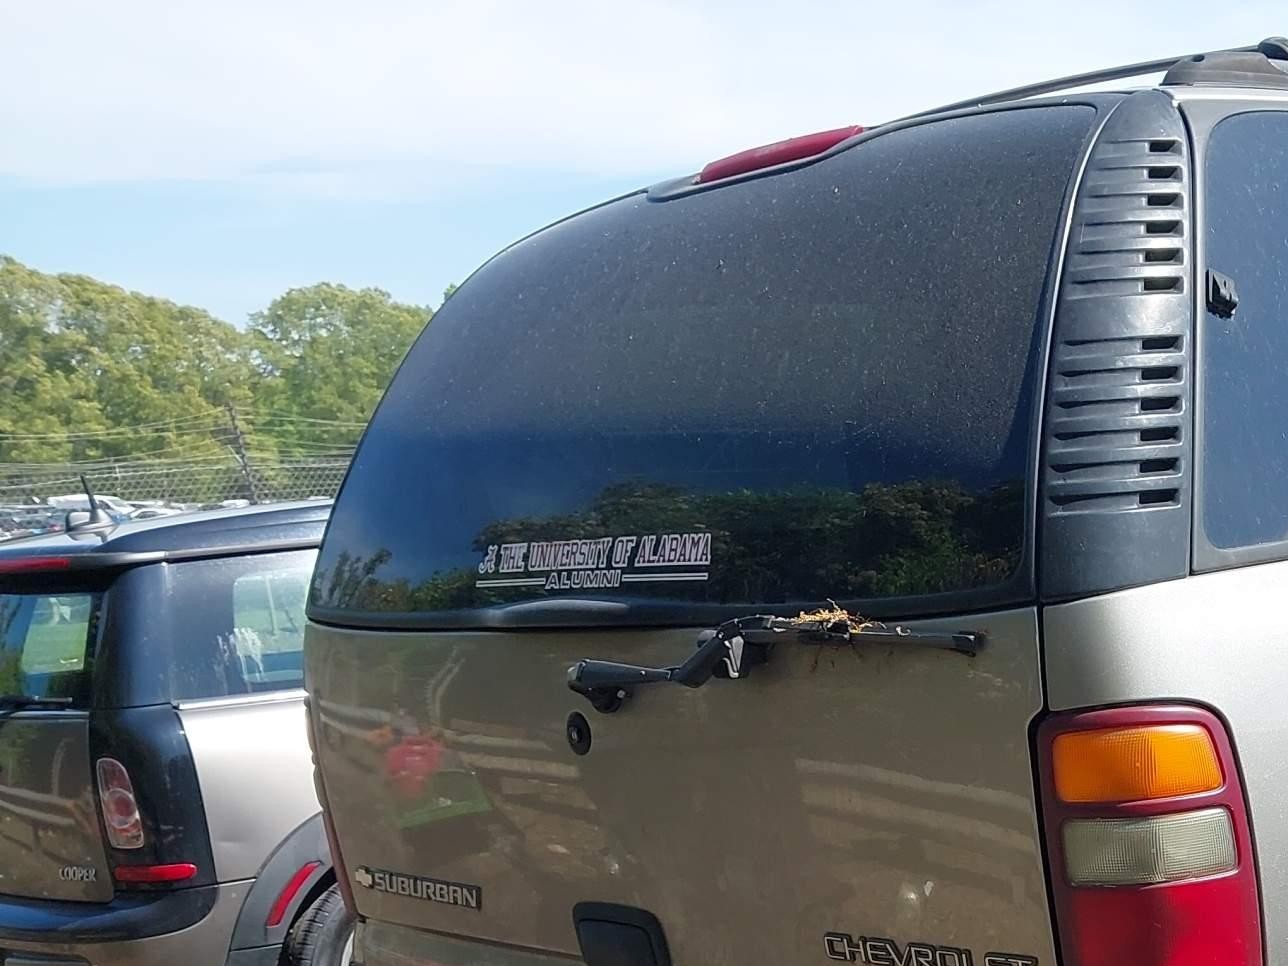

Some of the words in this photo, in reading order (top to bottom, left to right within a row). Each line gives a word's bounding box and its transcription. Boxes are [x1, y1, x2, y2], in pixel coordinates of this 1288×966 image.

[499, 543, 527, 572] THE
[528, 537, 612, 571] UNIVERSITY
[611, 536, 636, 568] OF
[634, 533, 711, 567] ALABAMA
[544, 570, 621, 589] ALUMNI
[59, 866, 96, 881] COOPER
[374, 872, 477, 907] SUBURBAN
